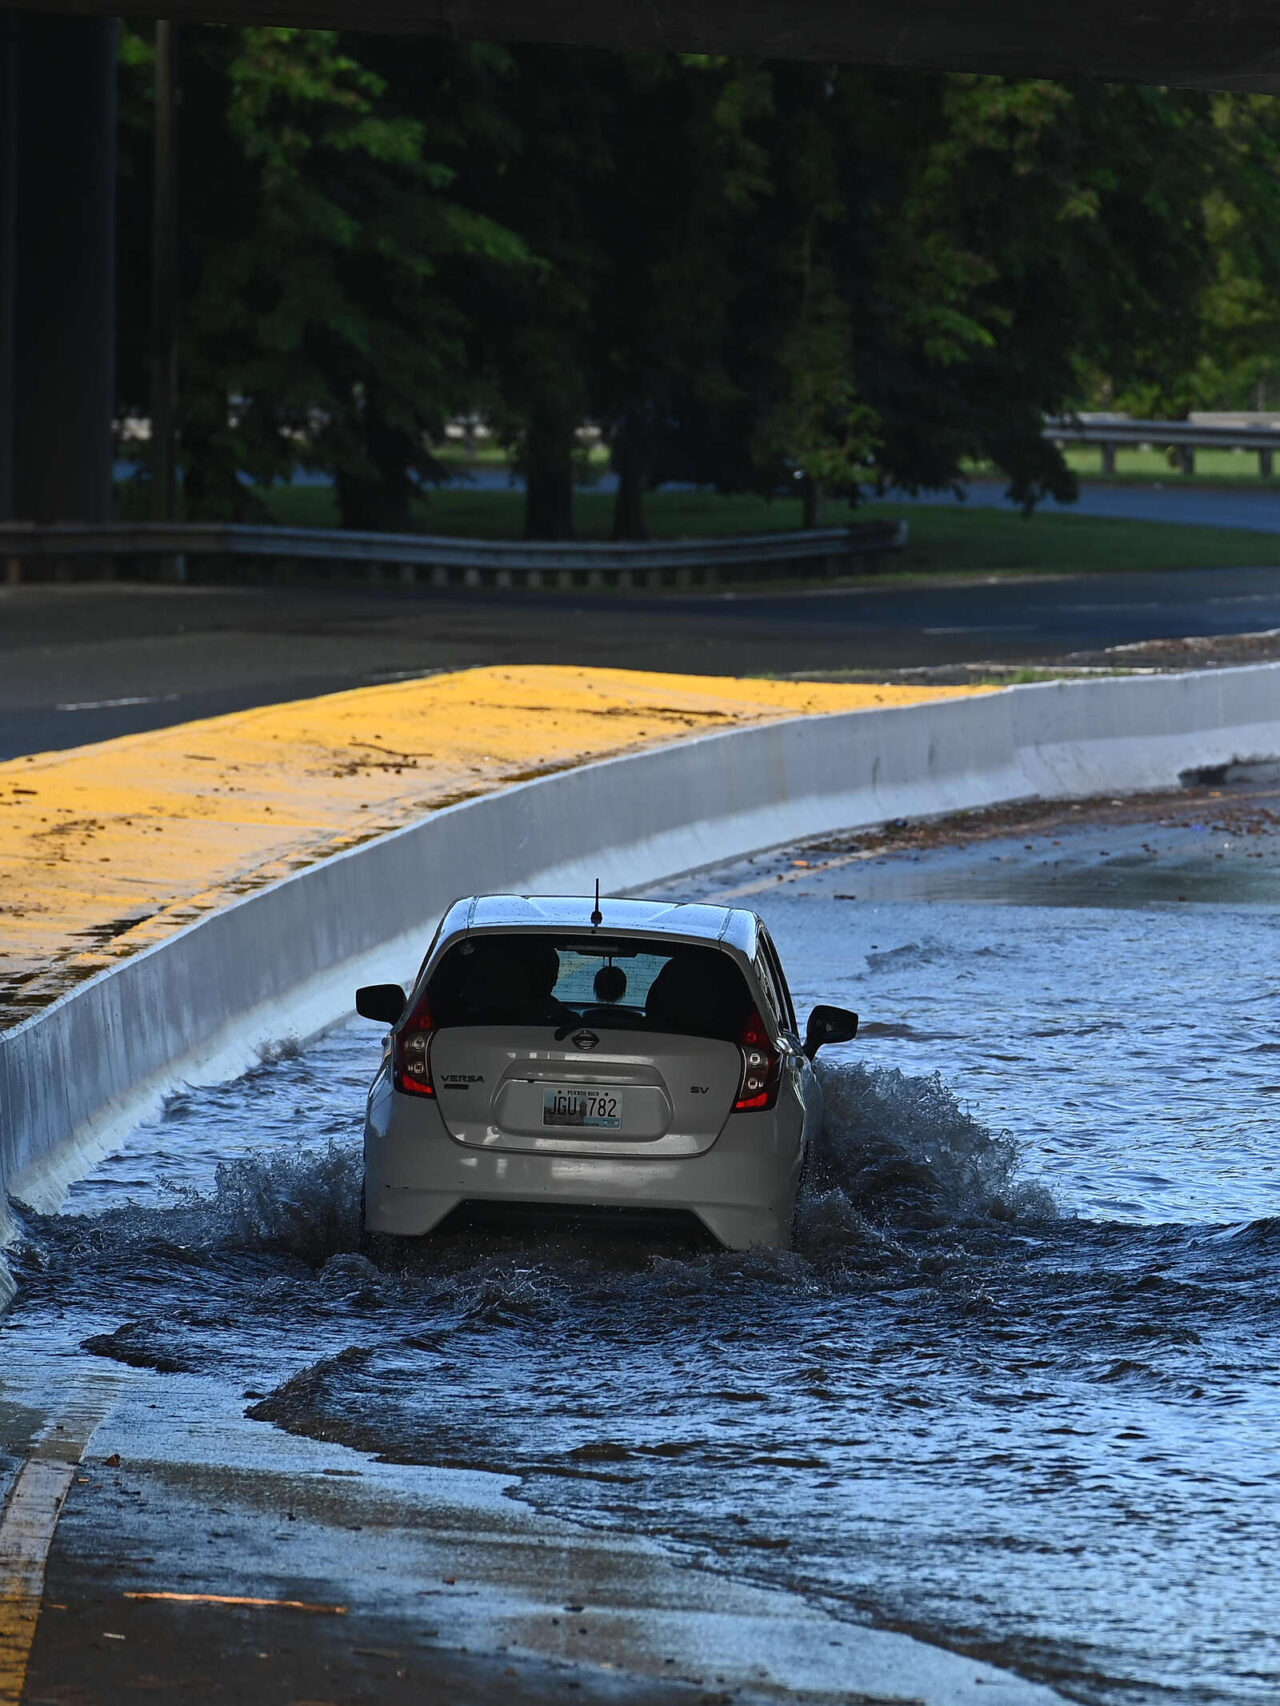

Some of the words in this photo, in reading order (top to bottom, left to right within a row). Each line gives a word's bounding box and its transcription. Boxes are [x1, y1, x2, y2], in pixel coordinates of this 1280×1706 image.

[440, 1074, 485, 1083] VERSA
[690, 1086, 709, 1094] SV
[552, 1096, 576, 1115] JGU
[588, 1097, 617, 1117] 782
